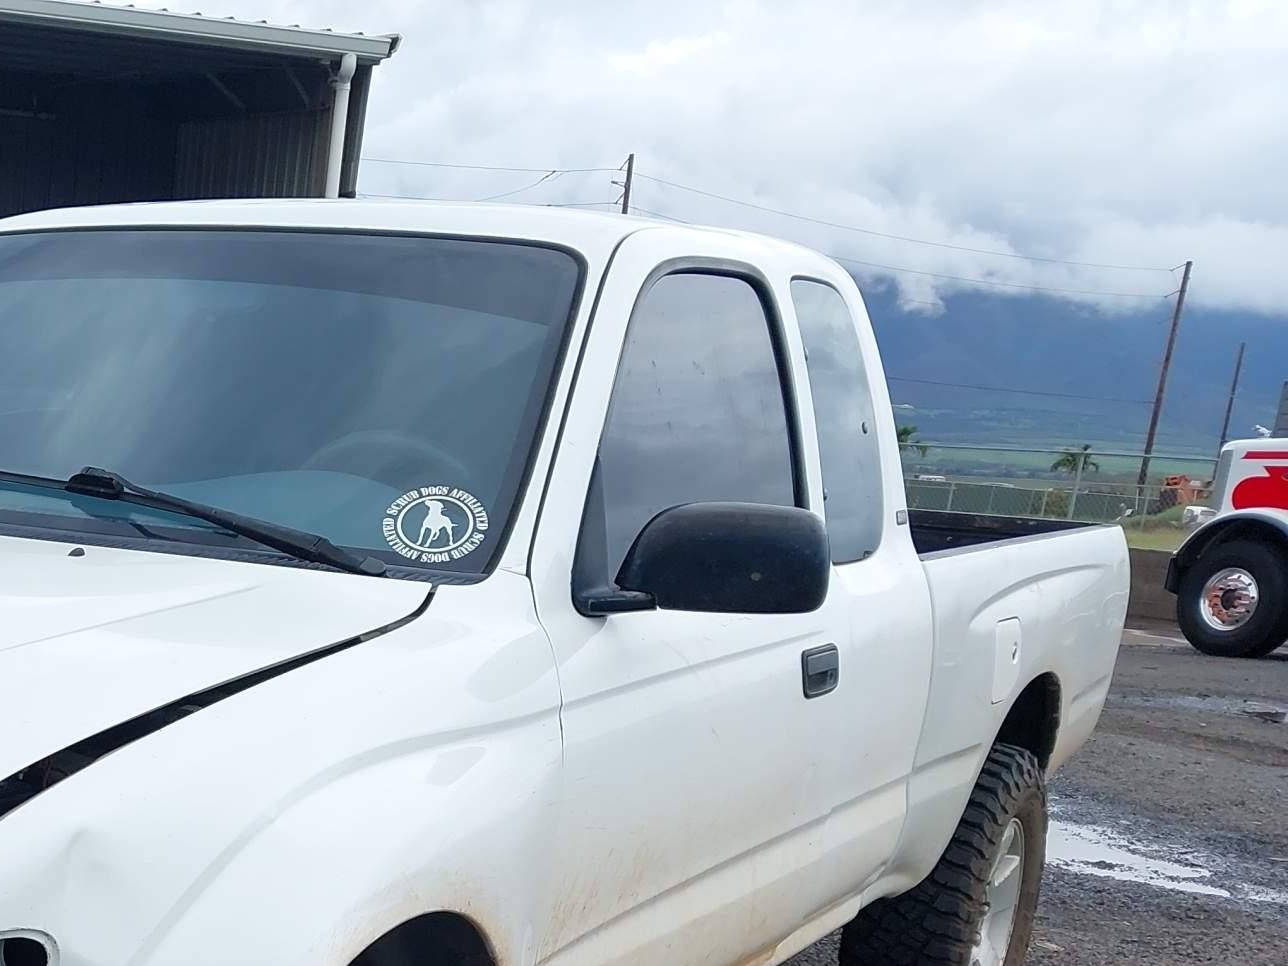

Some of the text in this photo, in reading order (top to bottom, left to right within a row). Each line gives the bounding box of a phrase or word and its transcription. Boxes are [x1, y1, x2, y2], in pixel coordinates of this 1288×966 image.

[383, 485, 489, 563] SCRUB DOGS AFFILIATED SCRUB DOGS AFFILIATED
